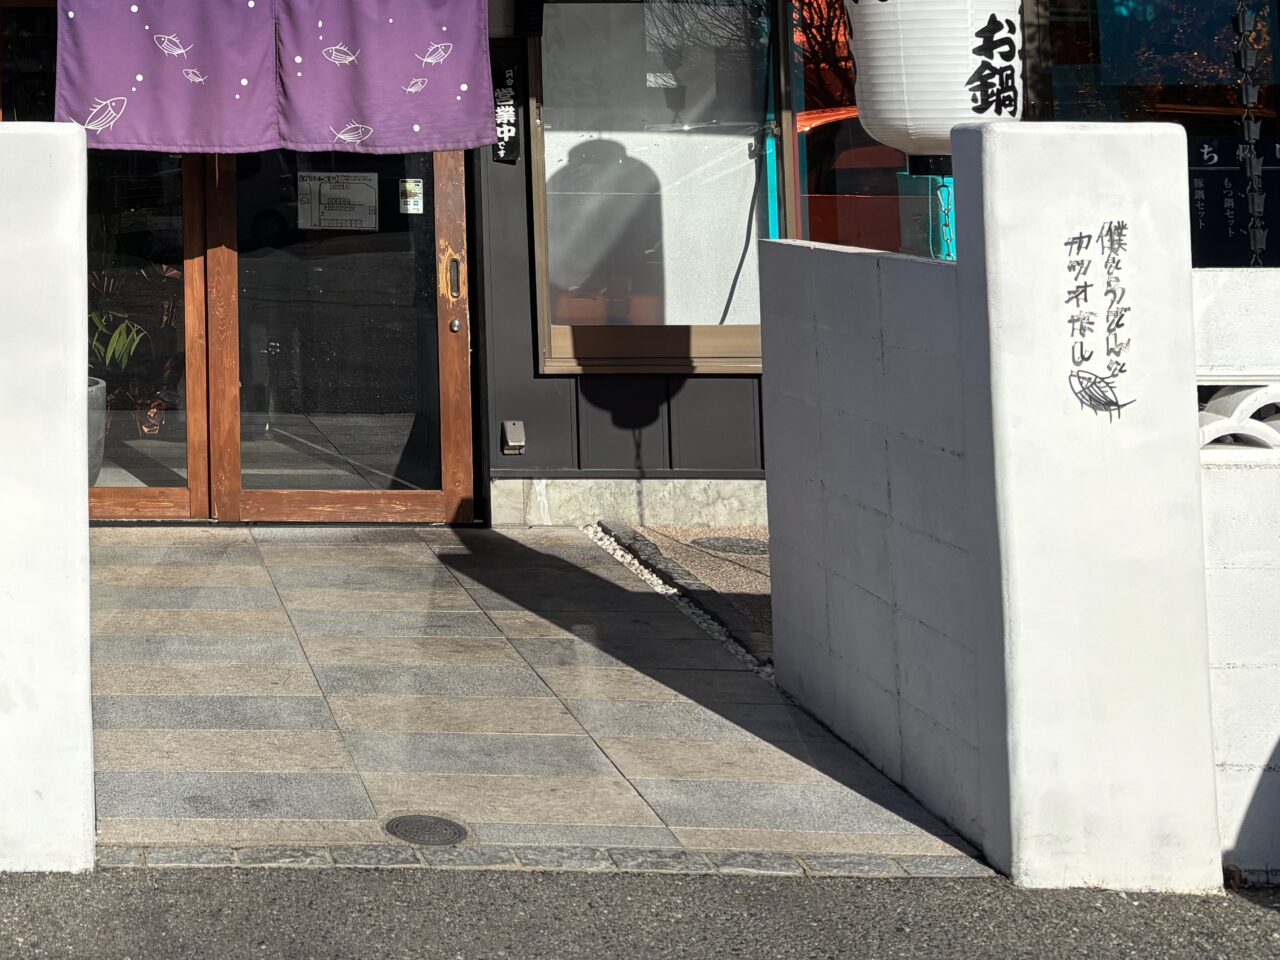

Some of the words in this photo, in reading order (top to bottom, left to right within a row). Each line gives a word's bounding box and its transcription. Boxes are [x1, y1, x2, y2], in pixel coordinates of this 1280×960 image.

[964, 12, 1018, 118] お鍋
[1223, 177, 1236, 238] もつ鍋セット
